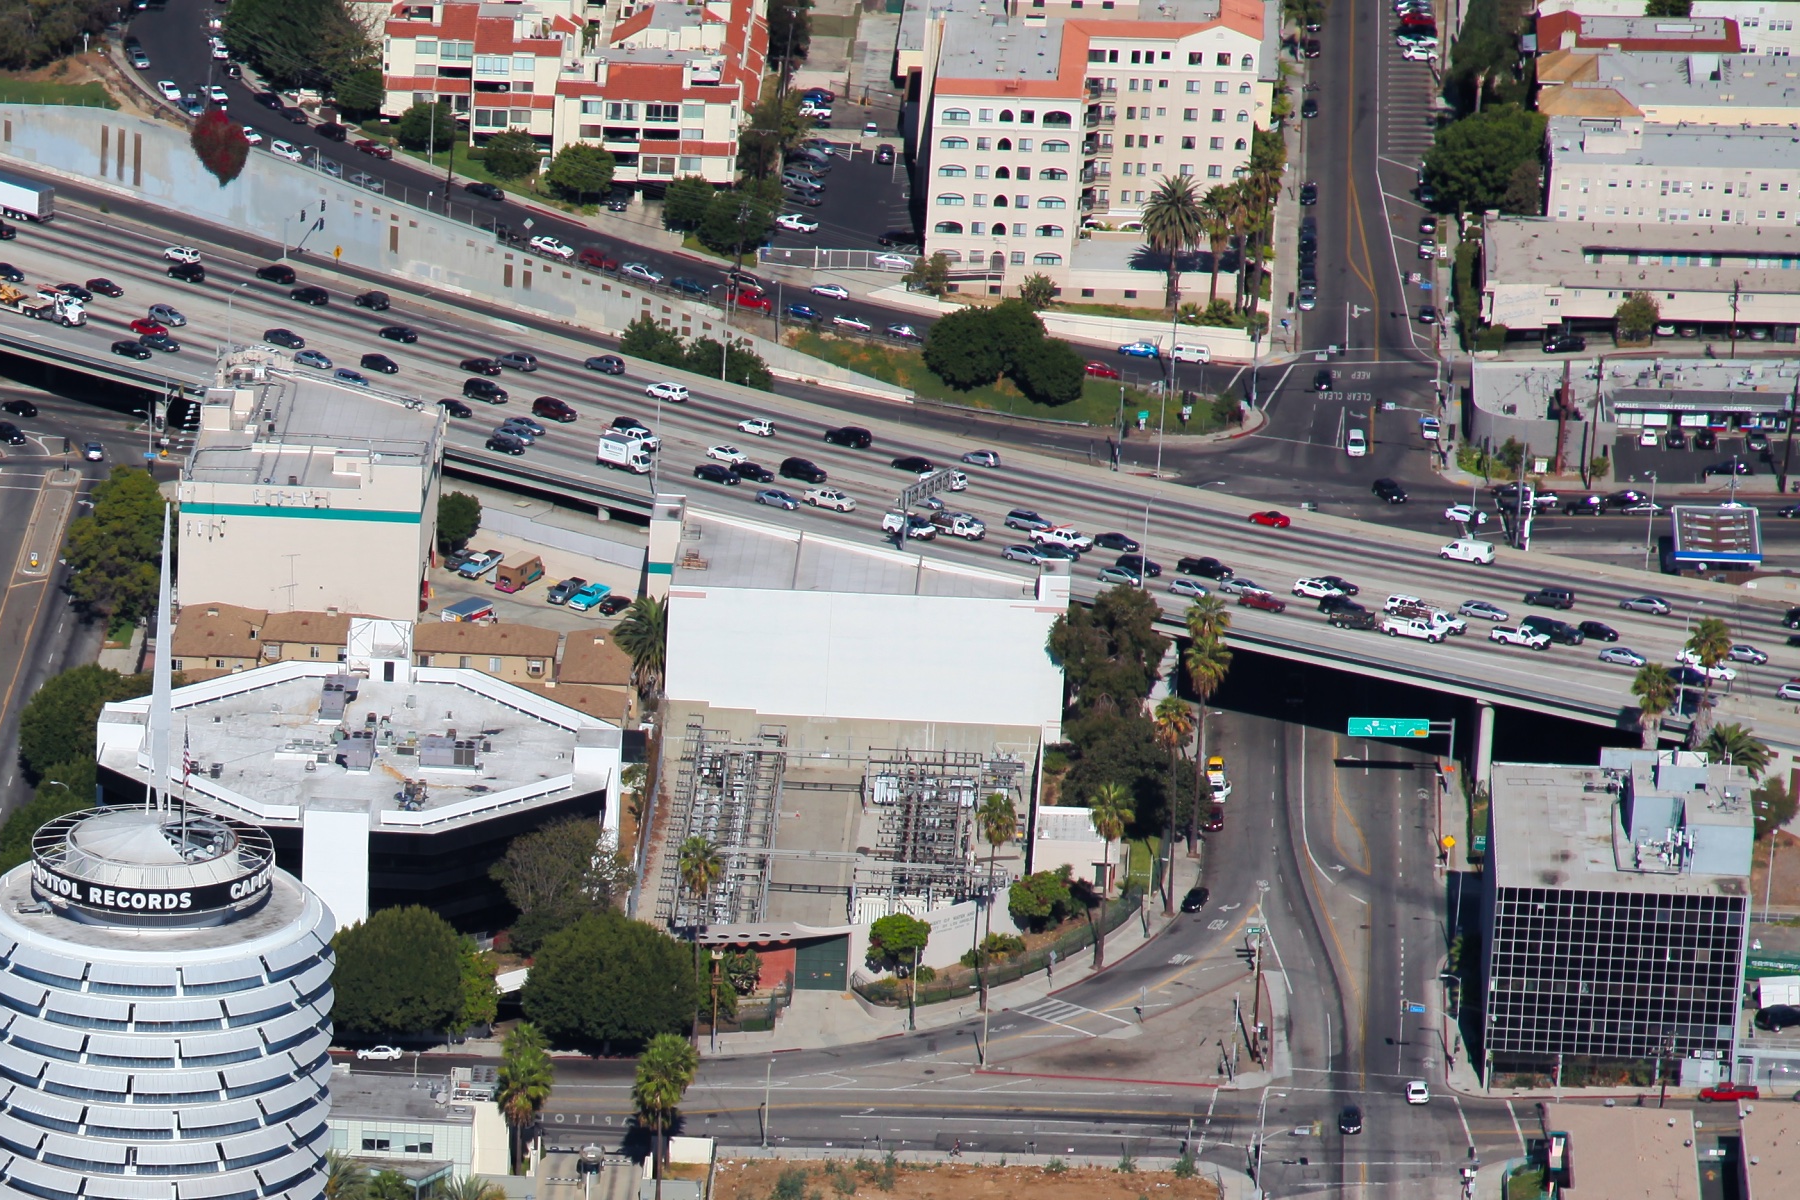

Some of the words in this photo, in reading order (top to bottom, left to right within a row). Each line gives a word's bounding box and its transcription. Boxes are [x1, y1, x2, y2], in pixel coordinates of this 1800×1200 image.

[1351, 371, 1371, 380] KEEP
[1318, 391, 1343, 401] CLEAR
[1347, 392, 1372, 401] CLEAR
[230, 860, 276, 900] CAPITO
[89, 887, 192, 909] RECORDS
